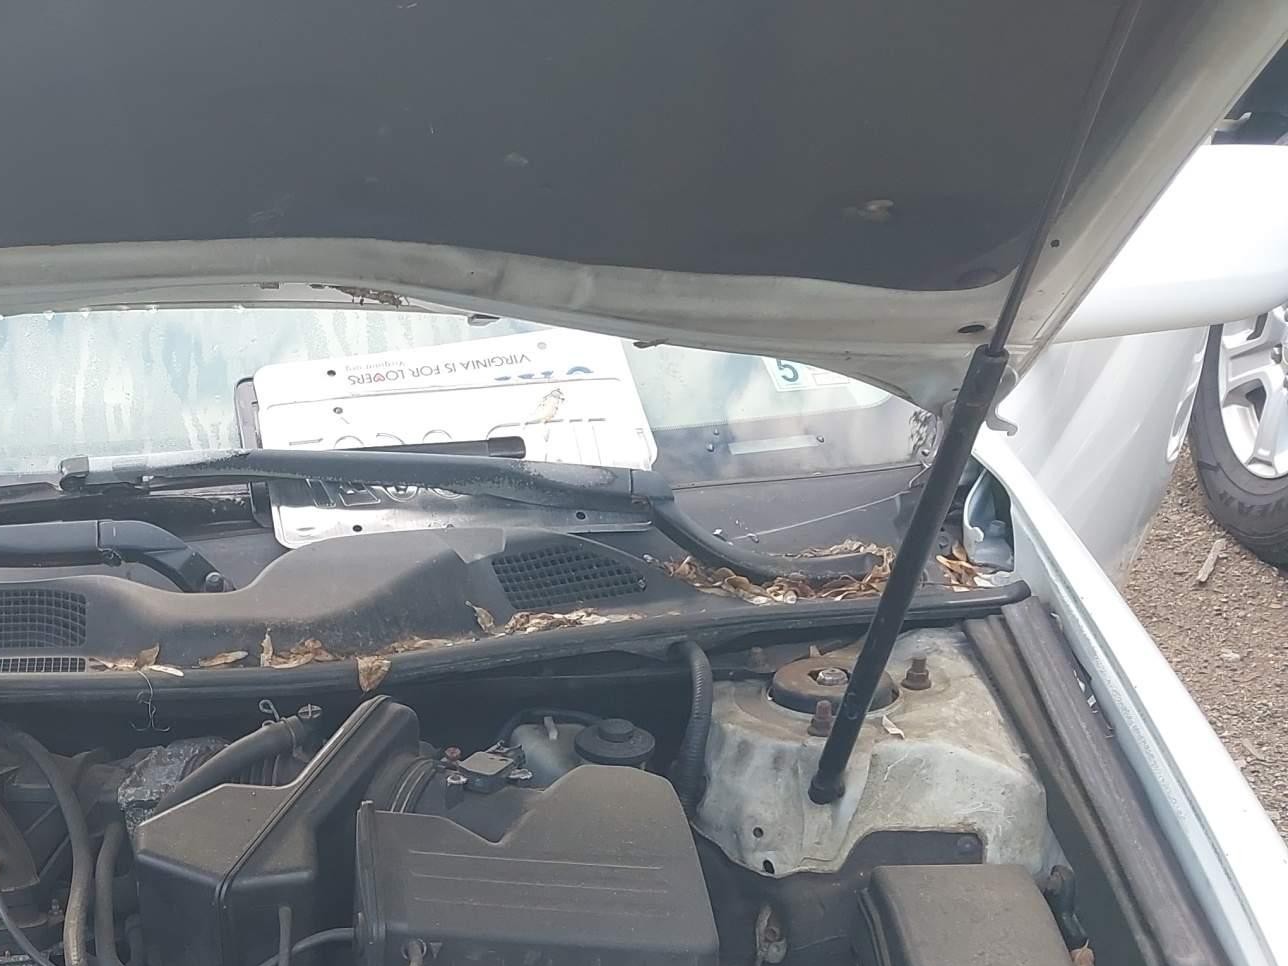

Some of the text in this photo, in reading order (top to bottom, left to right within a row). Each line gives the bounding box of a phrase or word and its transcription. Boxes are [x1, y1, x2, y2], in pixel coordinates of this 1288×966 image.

[445, 363, 457, 374] IS
[459, 353, 531, 371] VIRGINIA
[409, 365, 441, 378] FOR
